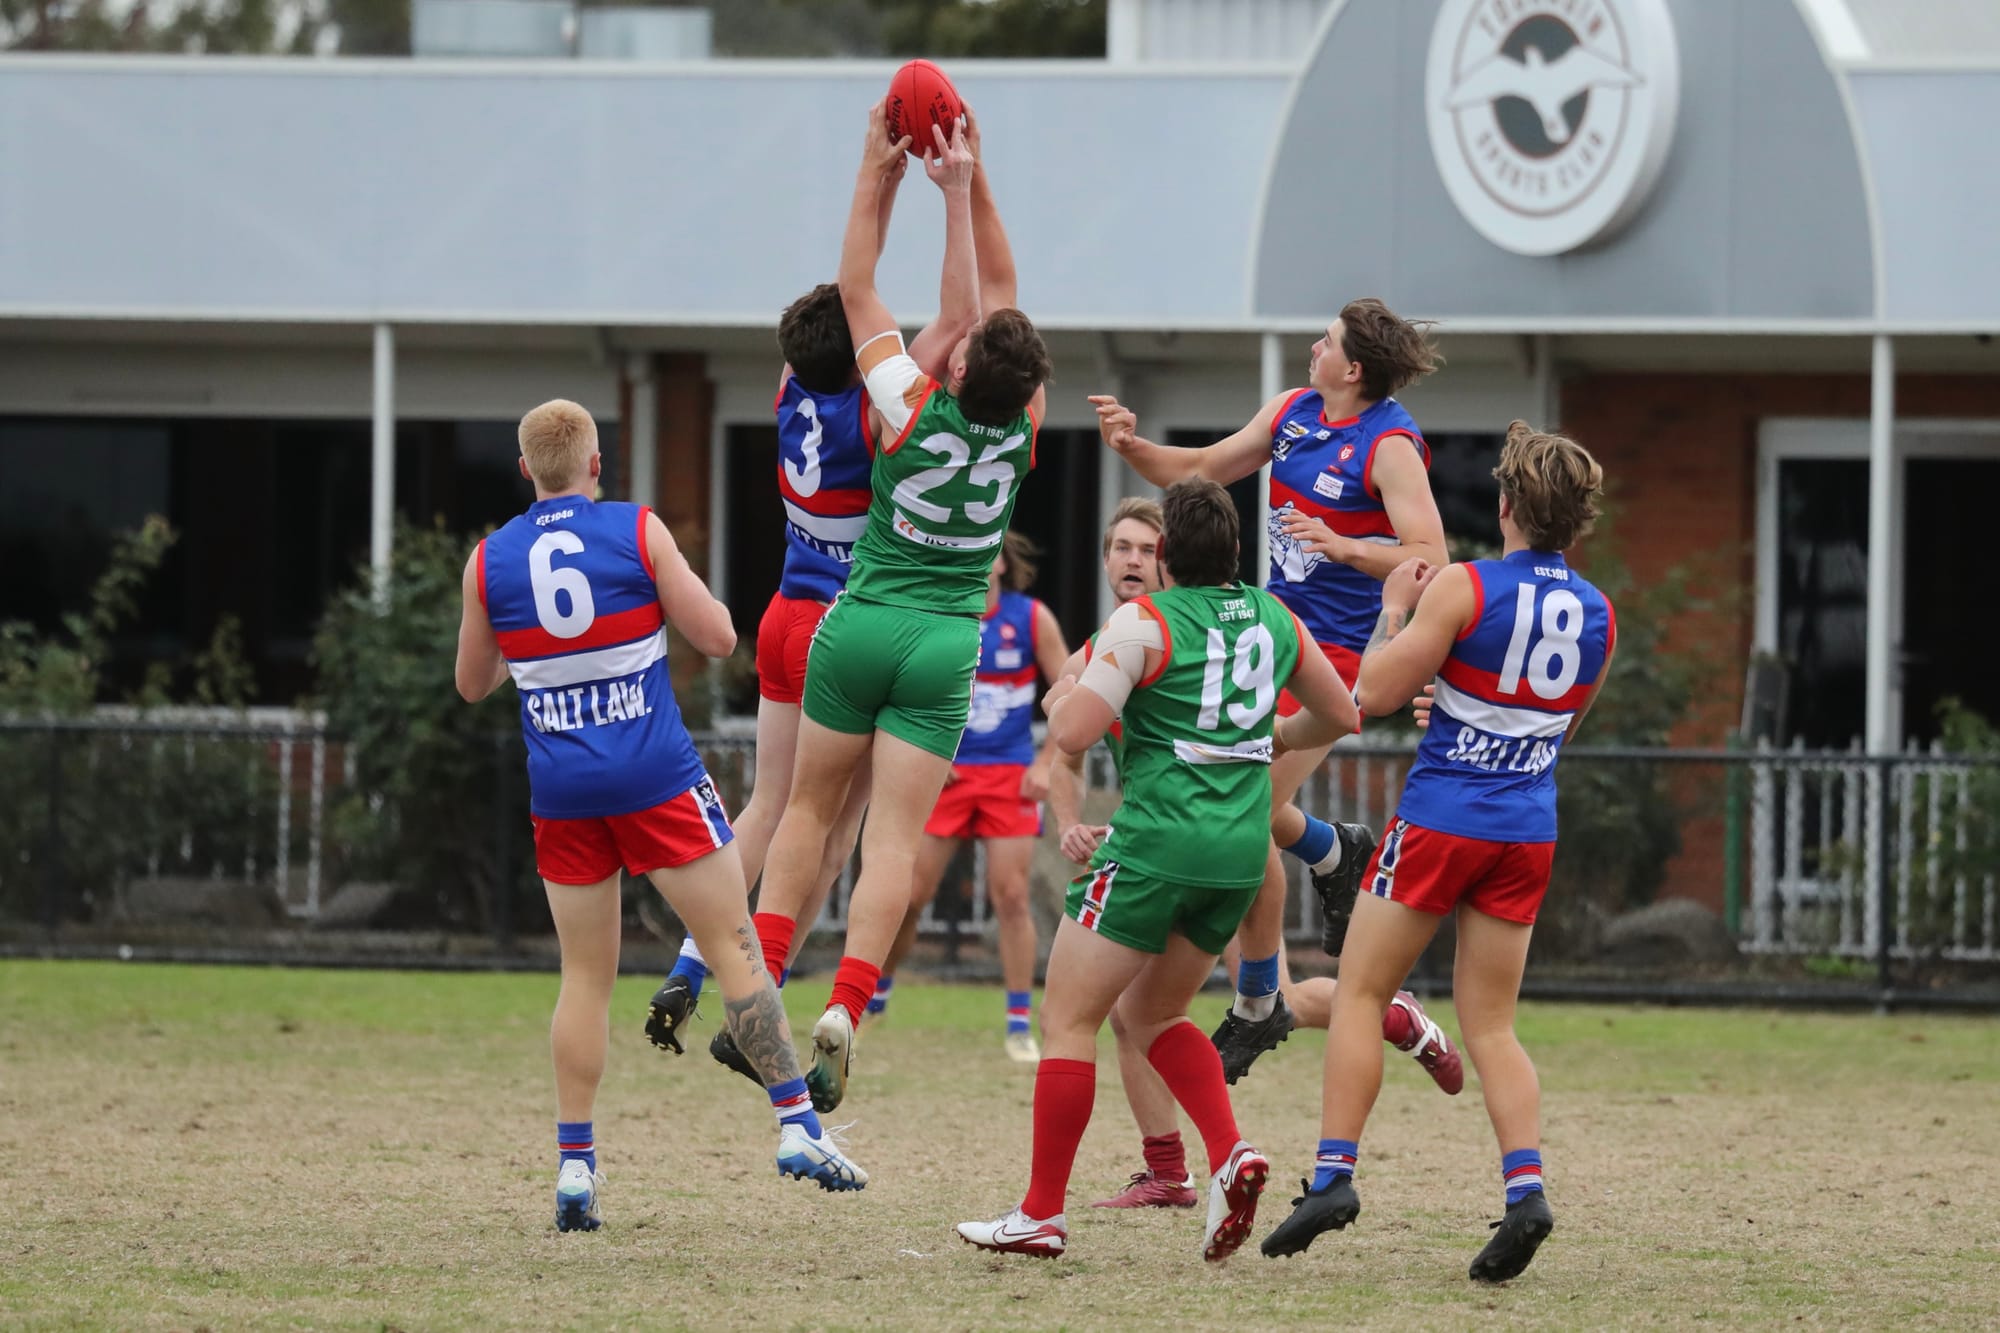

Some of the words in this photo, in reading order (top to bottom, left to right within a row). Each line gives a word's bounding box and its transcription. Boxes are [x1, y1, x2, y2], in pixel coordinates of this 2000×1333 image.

[785, 398, 823, 498] 3
[969, 423, 985, 435] EST
[986, 426, 1004, 440] 1947
[891, 432, 1026, 524] 25
[529, 530, 595, 639] 6
[1218, 611, 1235, 622] EST
[1237, 609, 1255, 620] 1947
[1222, 599, 1246, 610] TDFC
[1196, 622, 1276, 730] 19
[1497, 582, 1584, 700] 18
[527, 687, 584, 733] SALT
